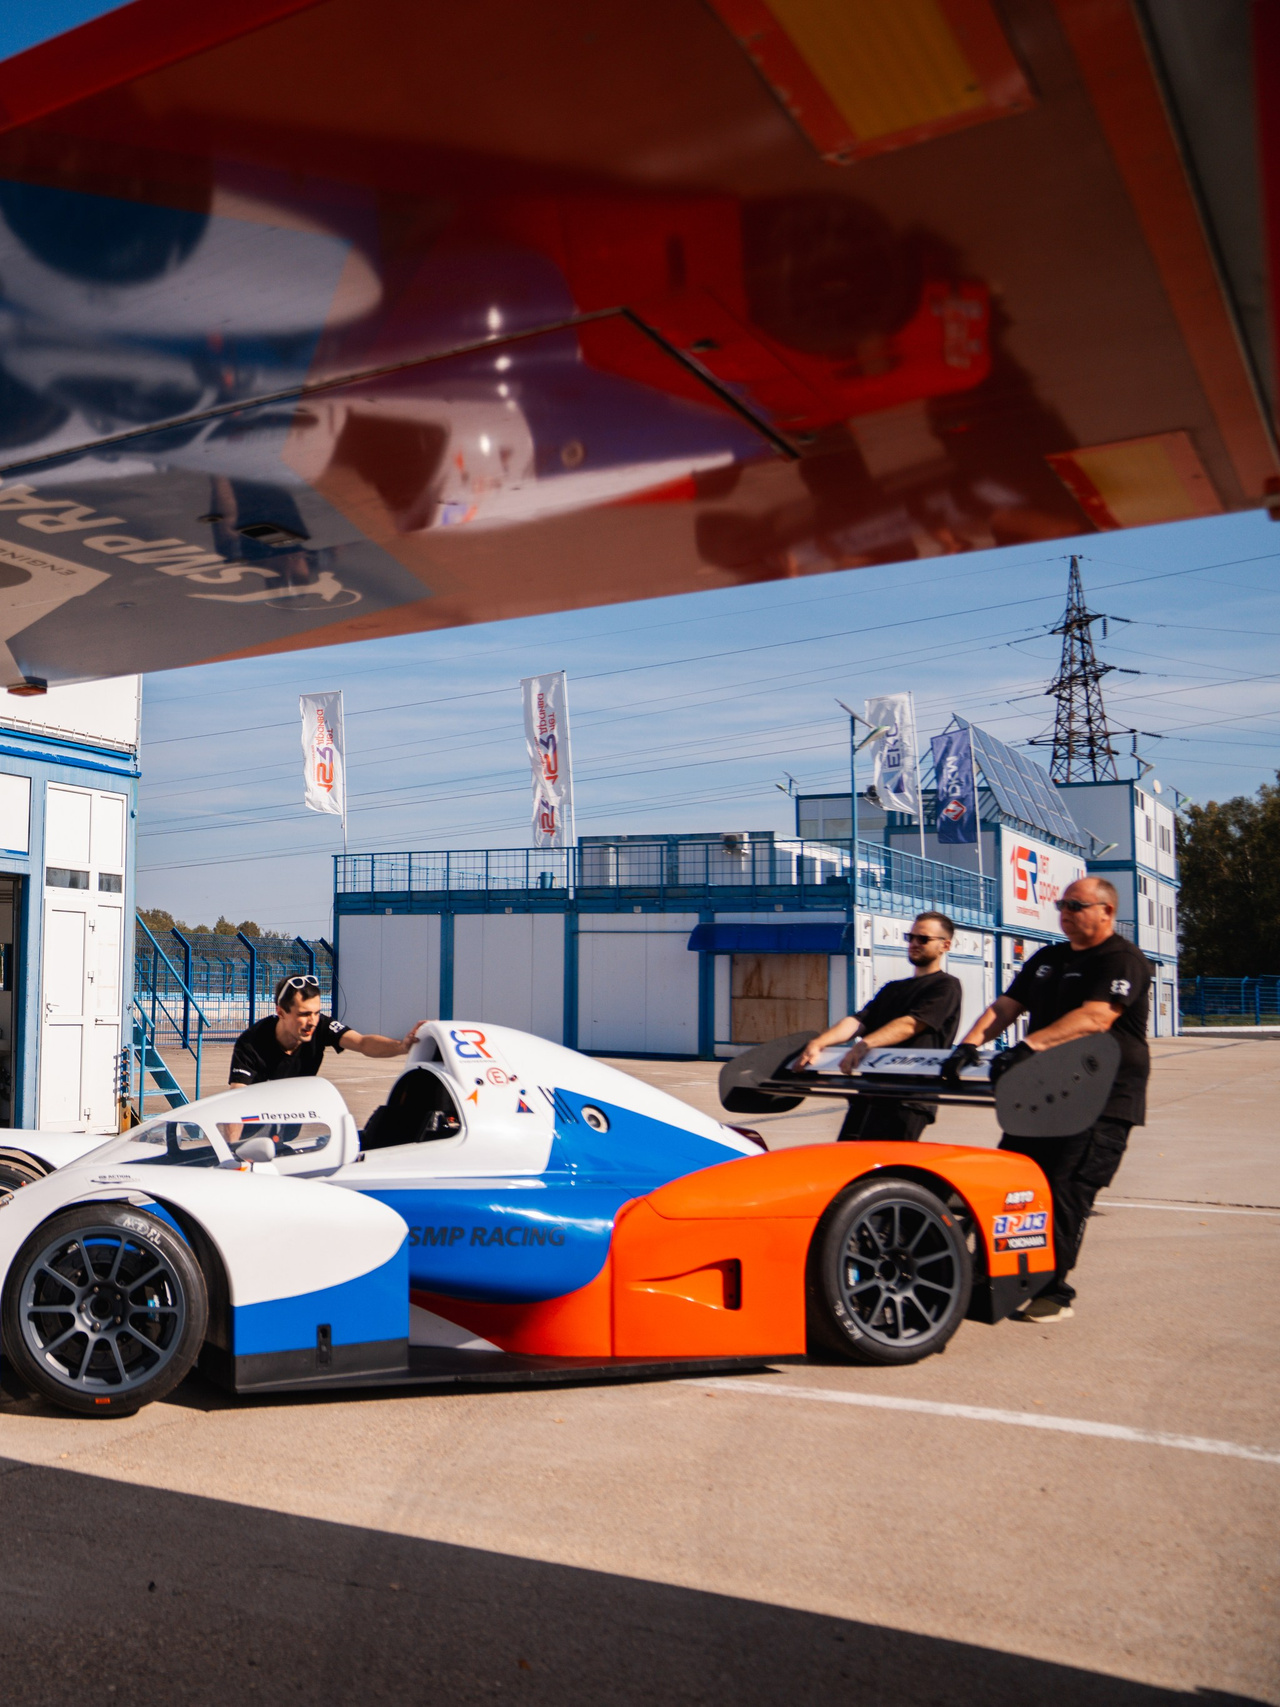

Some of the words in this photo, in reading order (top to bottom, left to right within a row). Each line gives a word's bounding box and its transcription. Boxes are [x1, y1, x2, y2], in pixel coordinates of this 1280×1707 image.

[81, 533, 282, 585] SMP
[261, 1112, 306, 1121] Петров
[409, 1226, 465, 1247] SMP
[469, 1226, 566, 1247] RACING
